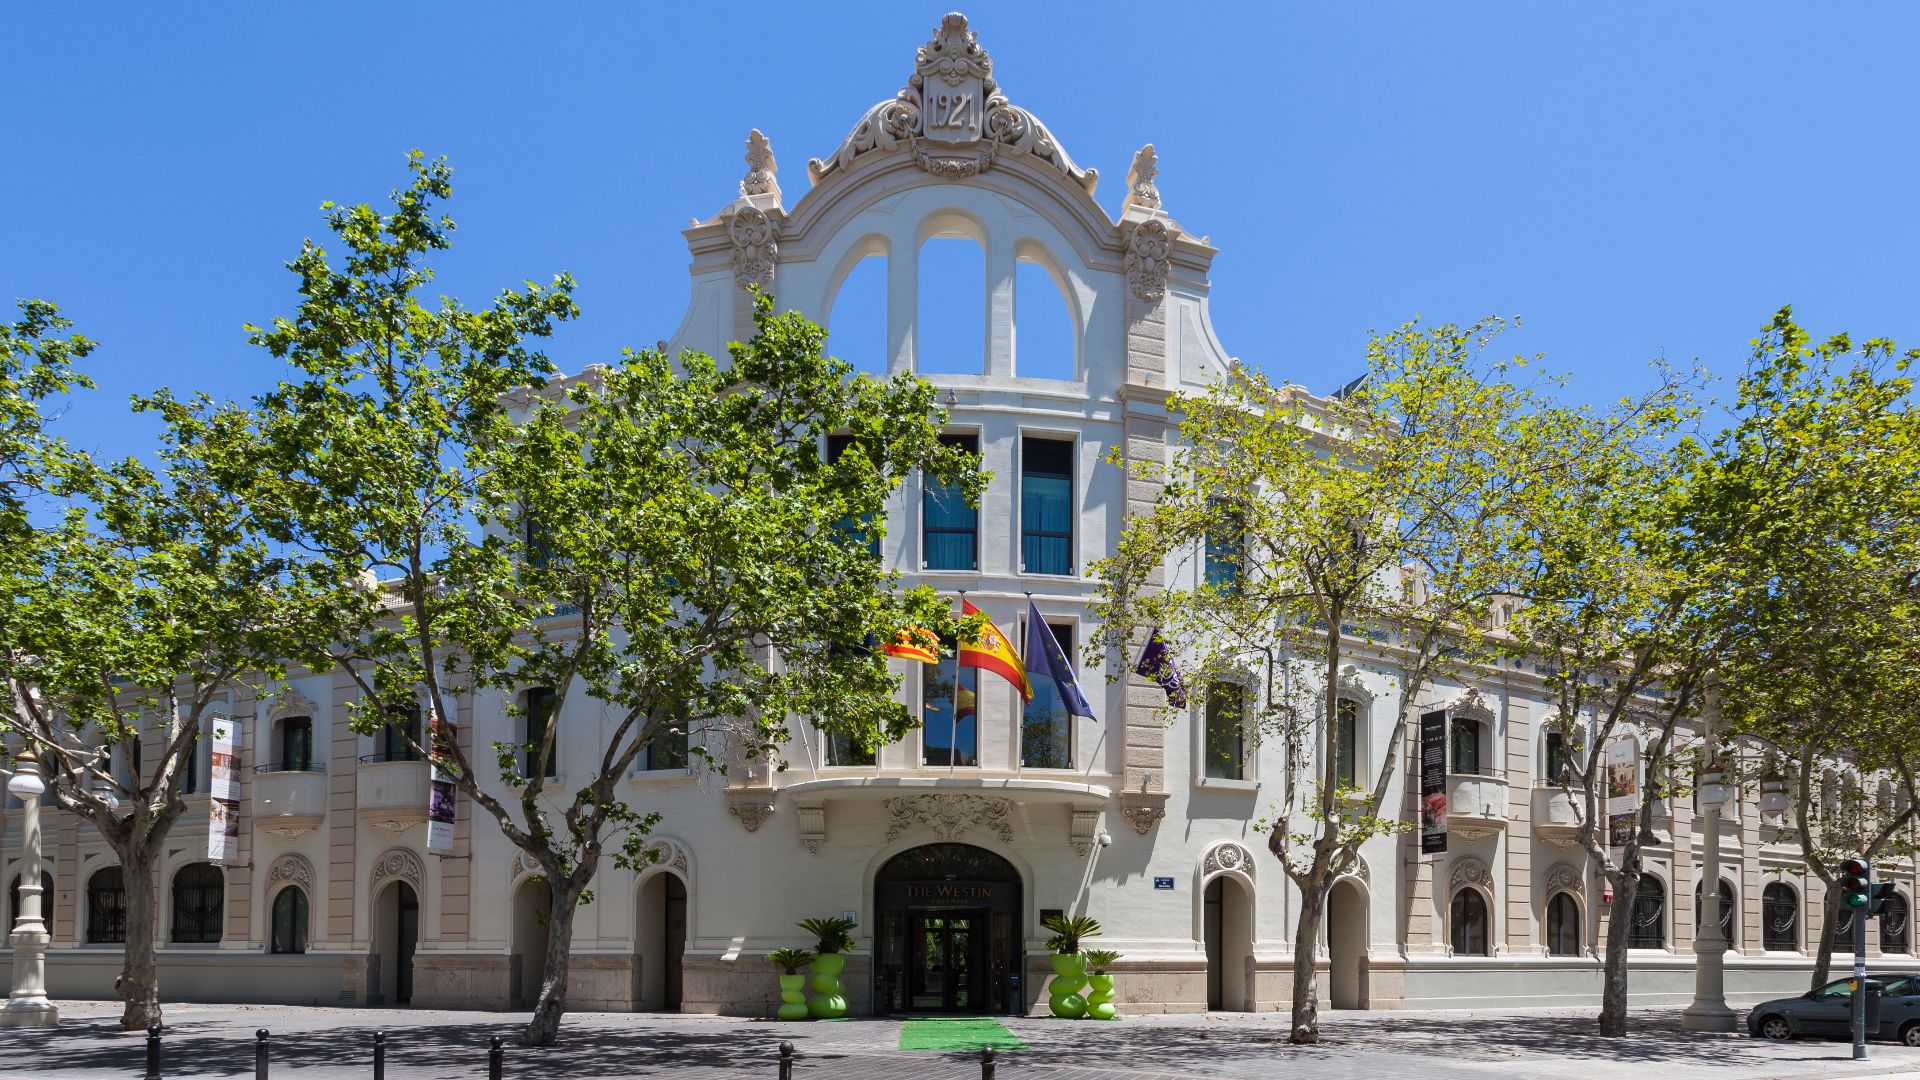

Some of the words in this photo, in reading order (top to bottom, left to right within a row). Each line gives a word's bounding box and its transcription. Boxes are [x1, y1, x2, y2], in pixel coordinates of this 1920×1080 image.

[930, 92, 976, 130] 1921
[906, 885, 932, 897] THE
[937, 884, 991, 897] WESTIN
